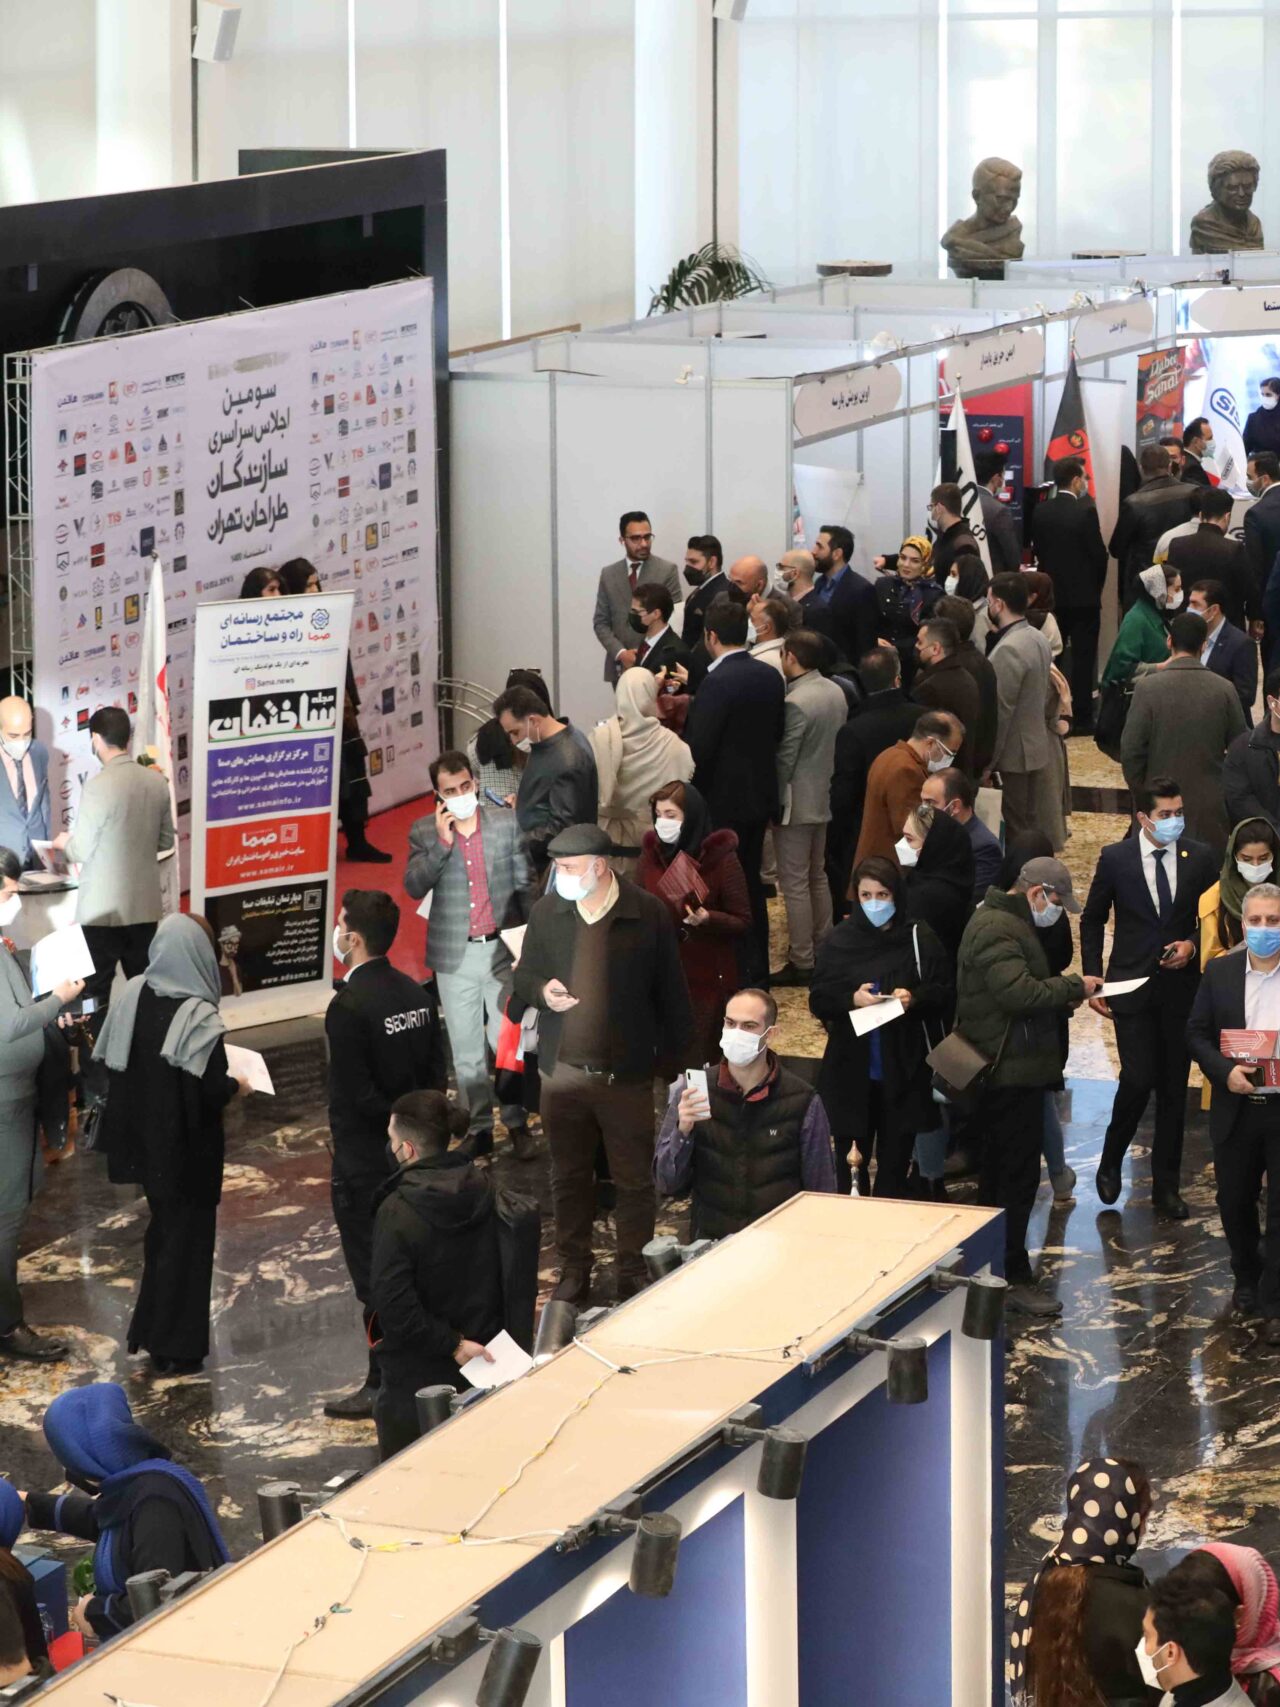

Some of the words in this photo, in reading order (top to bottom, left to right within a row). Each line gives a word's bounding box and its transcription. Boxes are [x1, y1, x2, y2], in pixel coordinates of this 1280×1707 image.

[222, 383, 277, 416] سومین
[254, 406, 291, 444] اجلاس
[207, 418, 254, 456] سراسری
[206, 447, 288, 500] سازندگان
[242, 492, 289, 534] طراحان
[206, 506, 243, 545] تهران
[233, 612, 263, 626] رسانه
[264, 609, 304, 627] مجتمع
[220, 629, 280, 649] ساختمان
[281, 631, 287, 643] و
[289, 628, 304, 642] راه
[307, 632, 331, 642] صما
[311, 691, 335, 705] مجله
[208, 692, 336, 740] ساختمان
[264, 750, 292, 763] برگزاری
[292, 748, 309, 760] مرکز
[242, 832, 278, 847] صما
